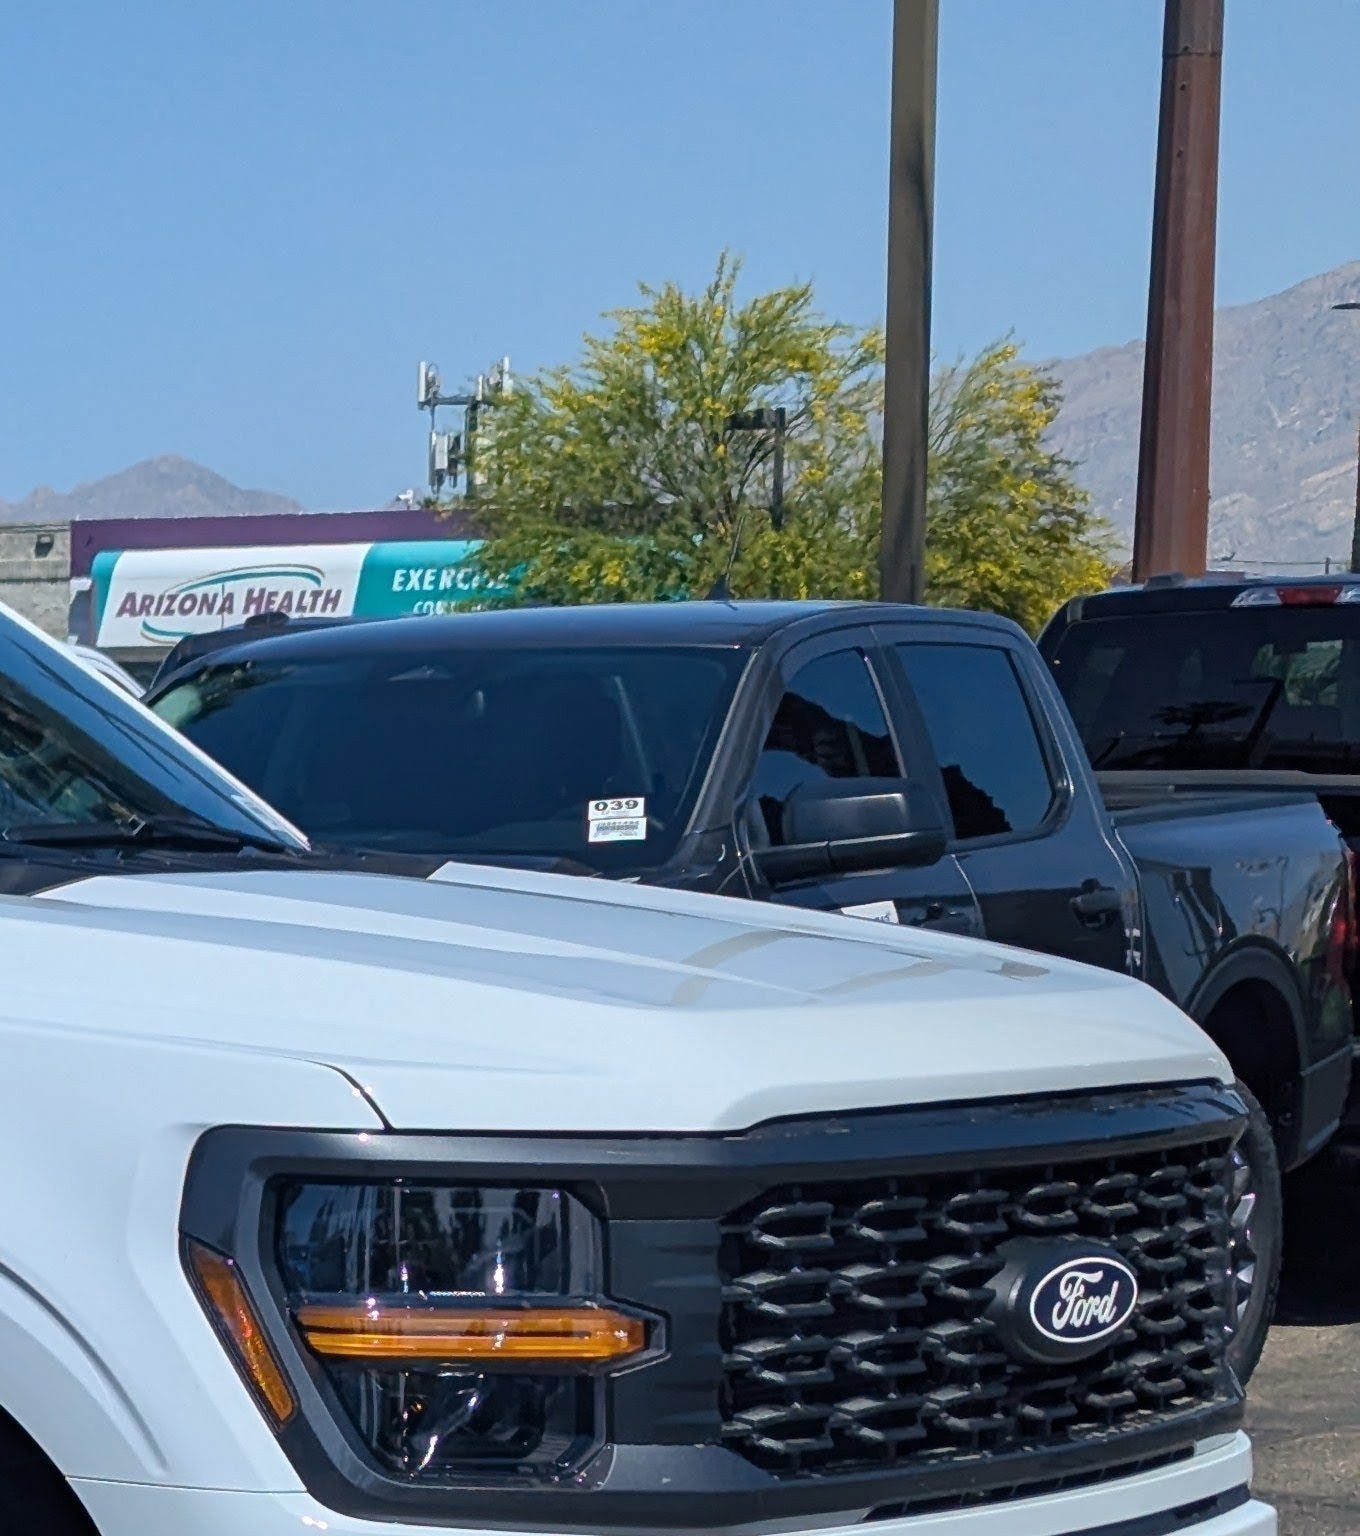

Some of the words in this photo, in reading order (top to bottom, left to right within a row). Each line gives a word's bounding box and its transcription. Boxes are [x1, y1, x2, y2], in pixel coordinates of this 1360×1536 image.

[115, 591, 235, 618] ARIZONA
[242, 587, 342, 616] HEALTH
[594, 800, 639, 811] 039
[1052, 1269, 1120, 1330] Ford
